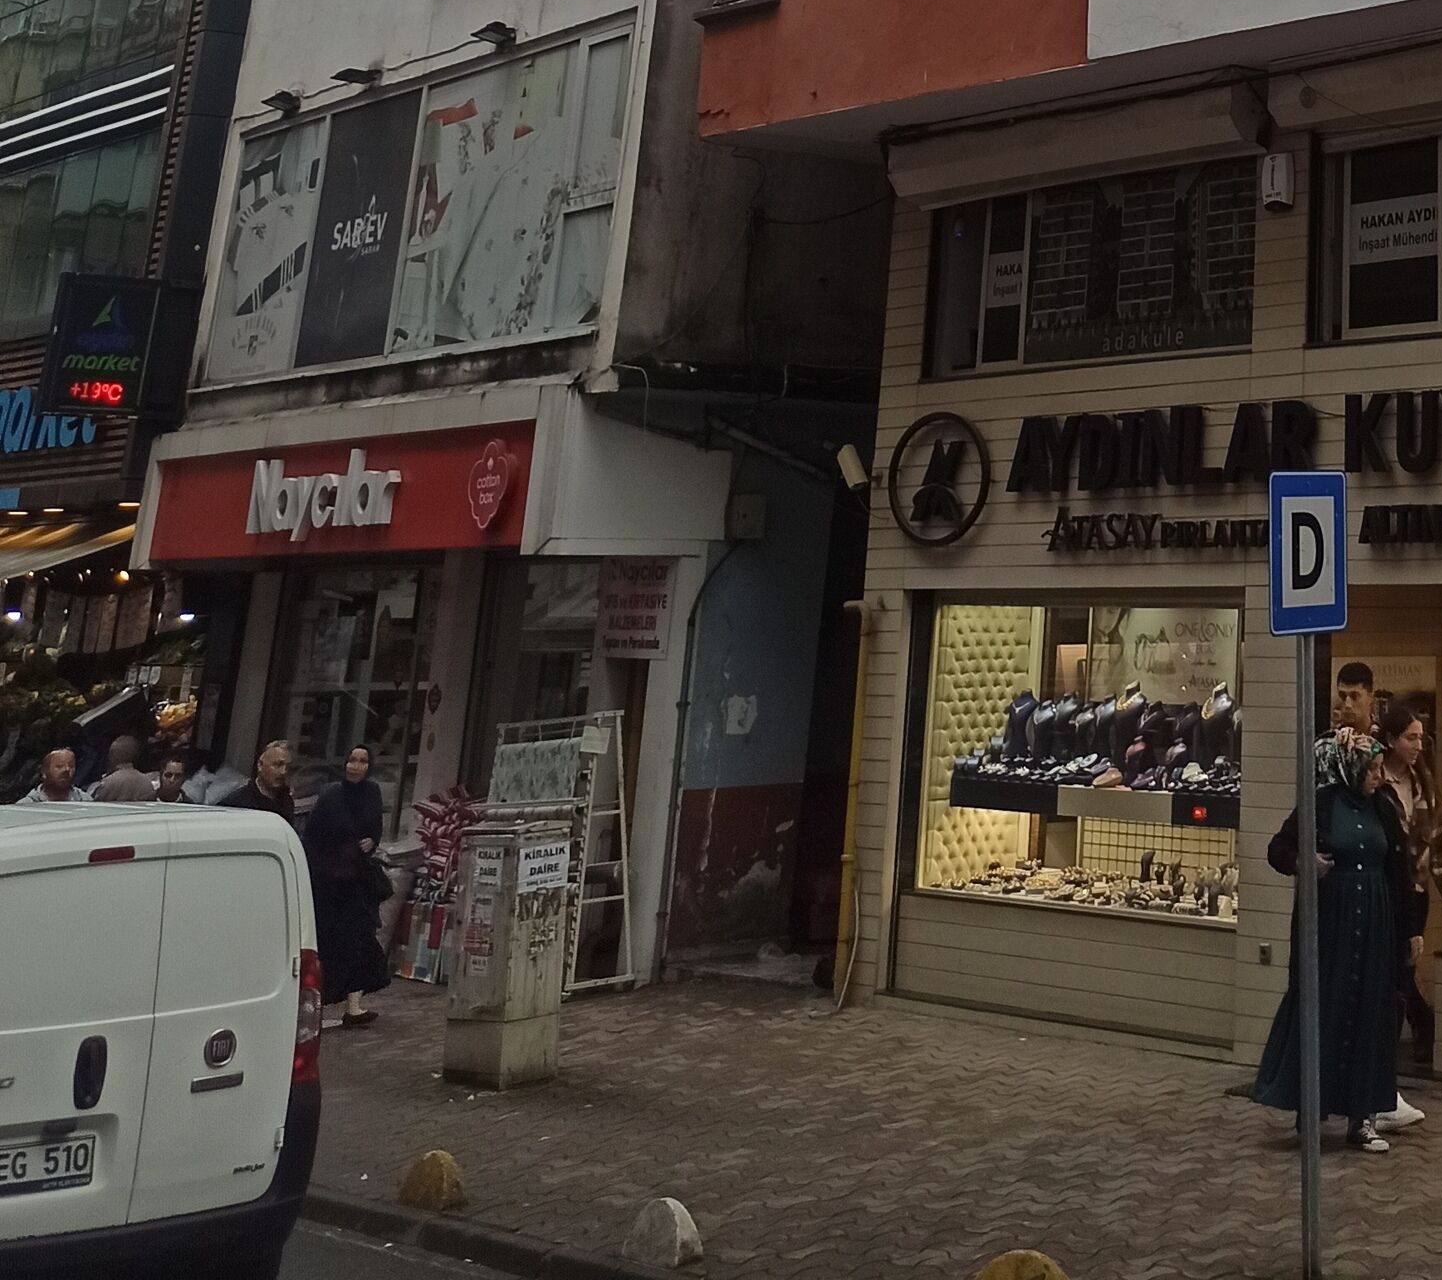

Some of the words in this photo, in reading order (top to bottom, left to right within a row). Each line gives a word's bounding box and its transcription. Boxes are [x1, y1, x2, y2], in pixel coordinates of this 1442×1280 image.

[1360, 212, 1404, 229] HAKAN
[1101, 327, 1186, 353] adakule
[62, 353, 141, 372] market
[1005, 400, 1318, 493] AYDINLAR
[476, 474, 501, 489] cotton
[478, 490, 496, 505] box
[1291, 512, 1324, 590] D
[524, 846, 566, 861] KİRALIK
[529, 862, 560, 876] DAİRE
[43, 1143, 90, 1175] 510
